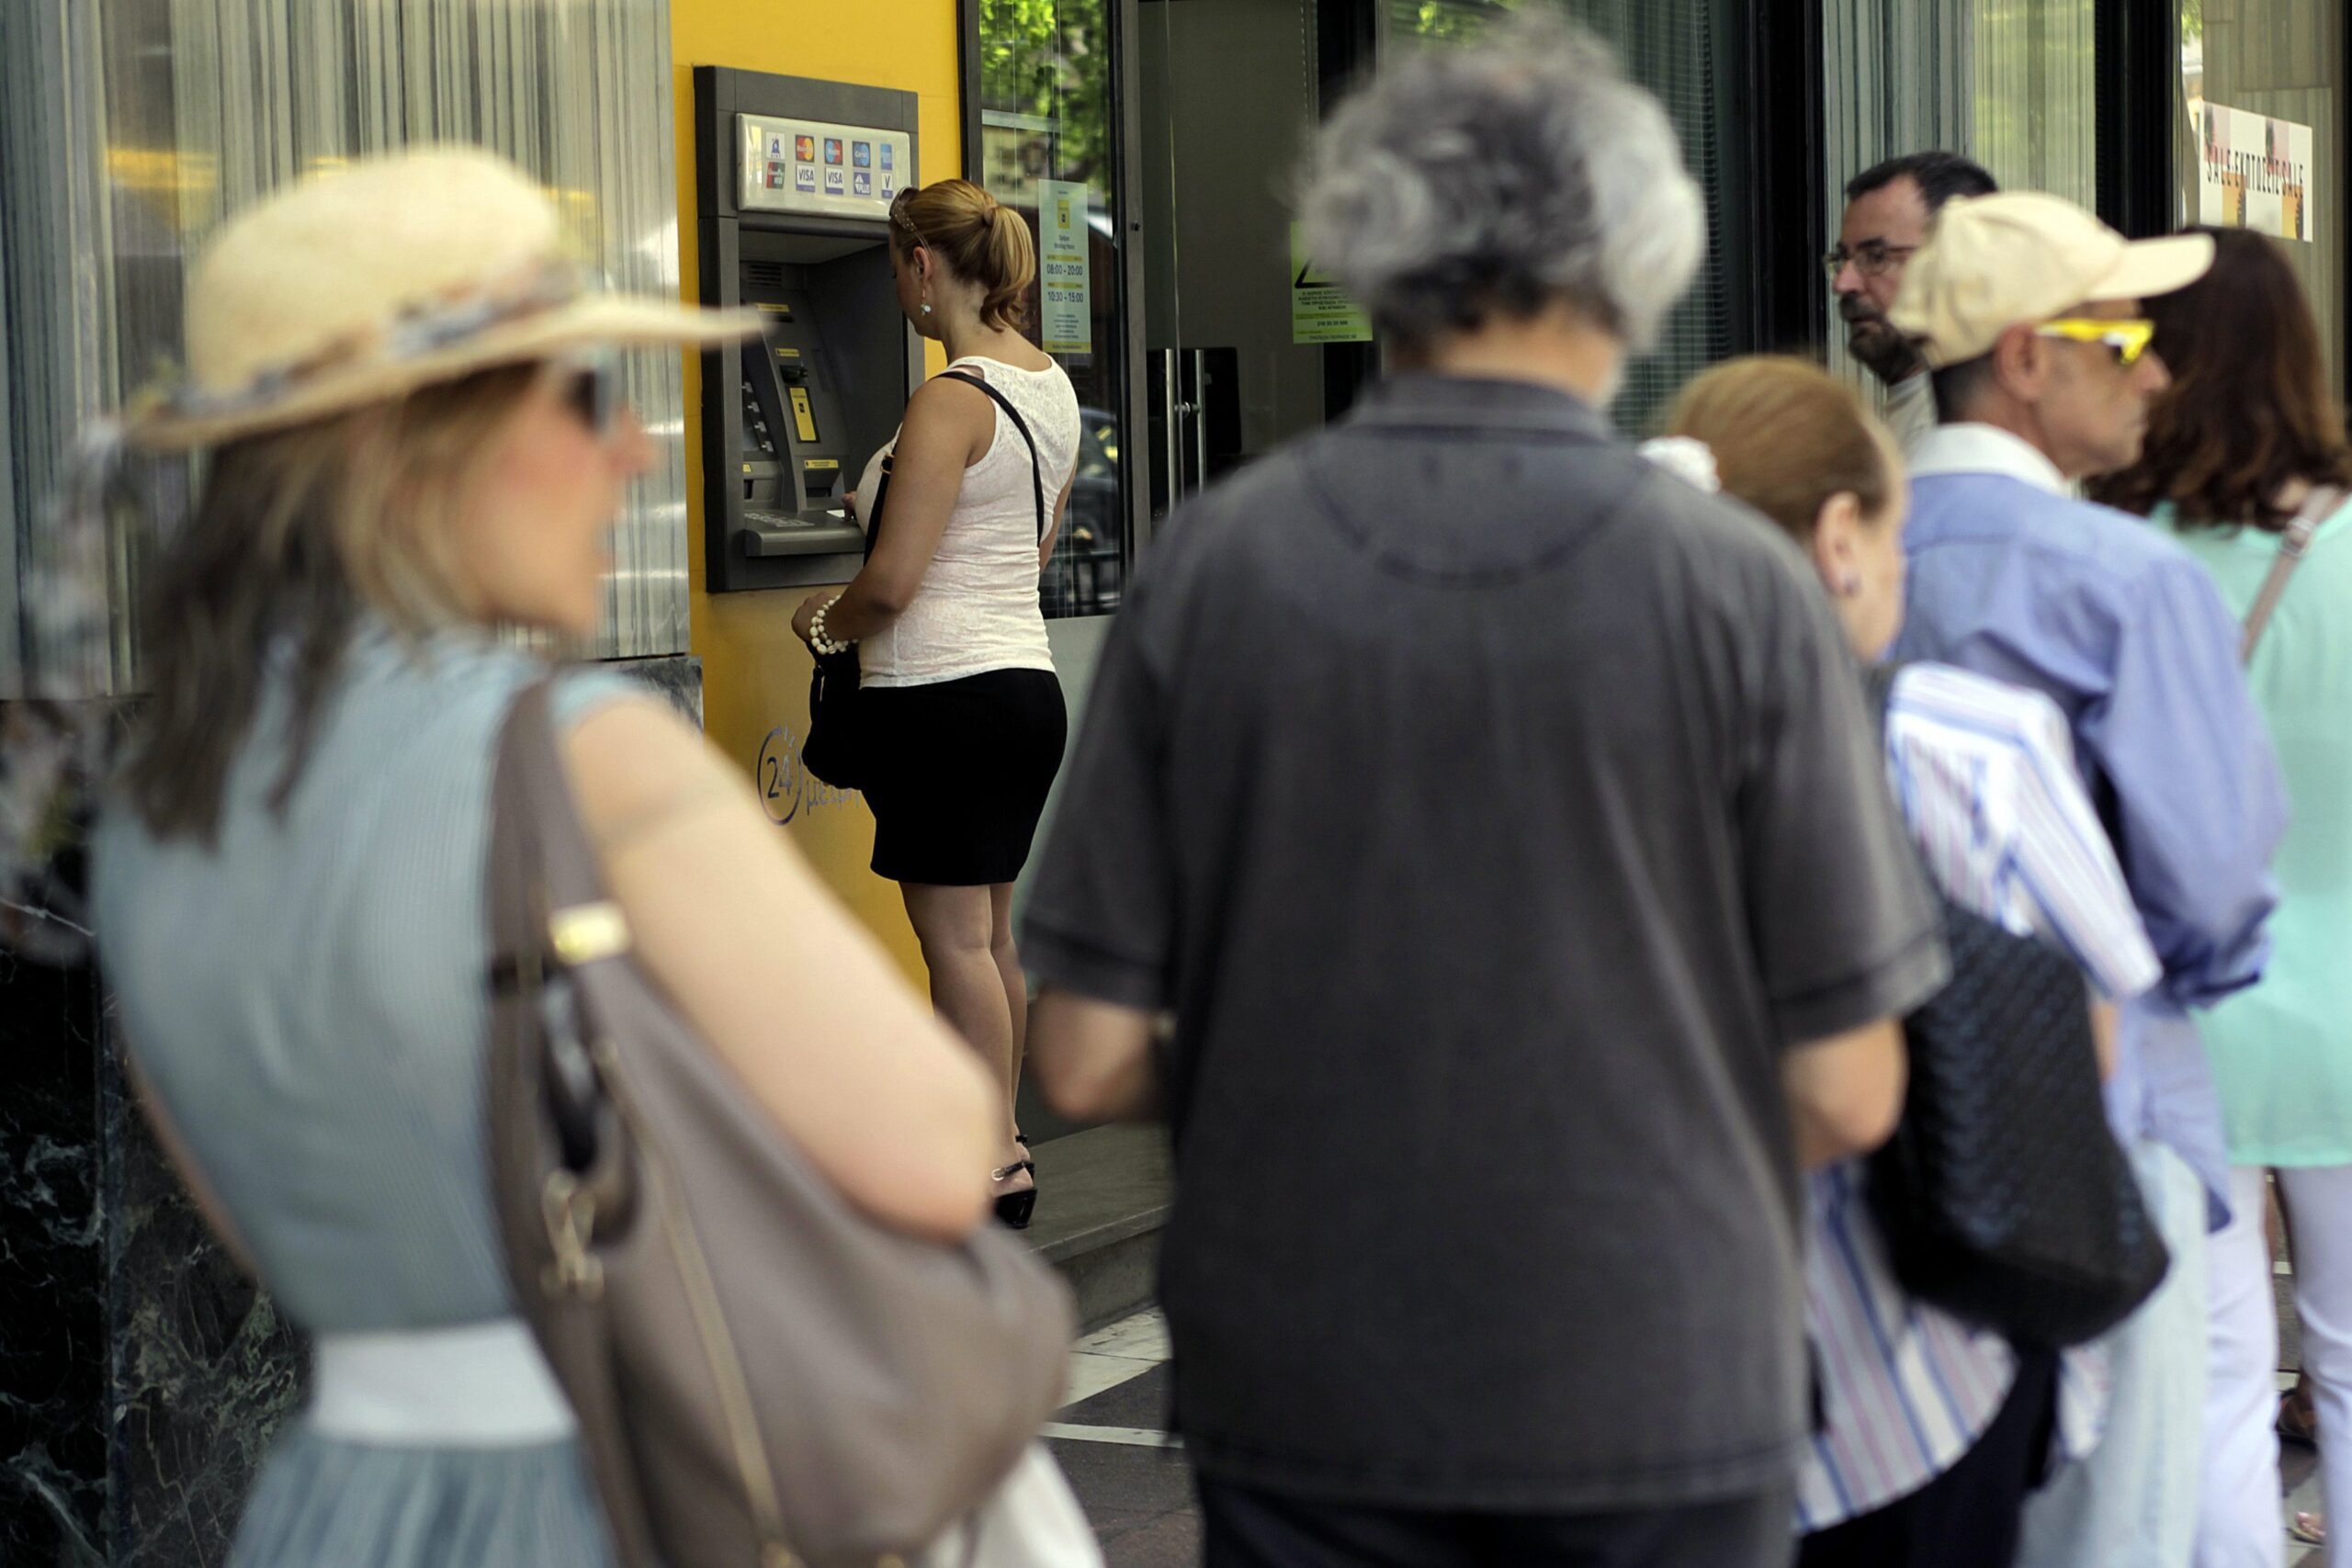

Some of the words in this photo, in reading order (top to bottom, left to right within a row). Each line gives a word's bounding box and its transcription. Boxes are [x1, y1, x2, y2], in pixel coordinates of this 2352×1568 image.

[798, 168, 815, 182] VISA
[827, 171, 843, 185] VISA
[2207, 145, 2232, 186] SALE
[2281, 161, 2303, 199] SALE
[1046, 264, 1063, 275] 08:00
[1068, 265, 1083, 276] 20:00
[1047, 291, 1063, 302] 10:30
[1068, 292, 1084, 302] 15:00
[767, 755, 793, 799] 24
